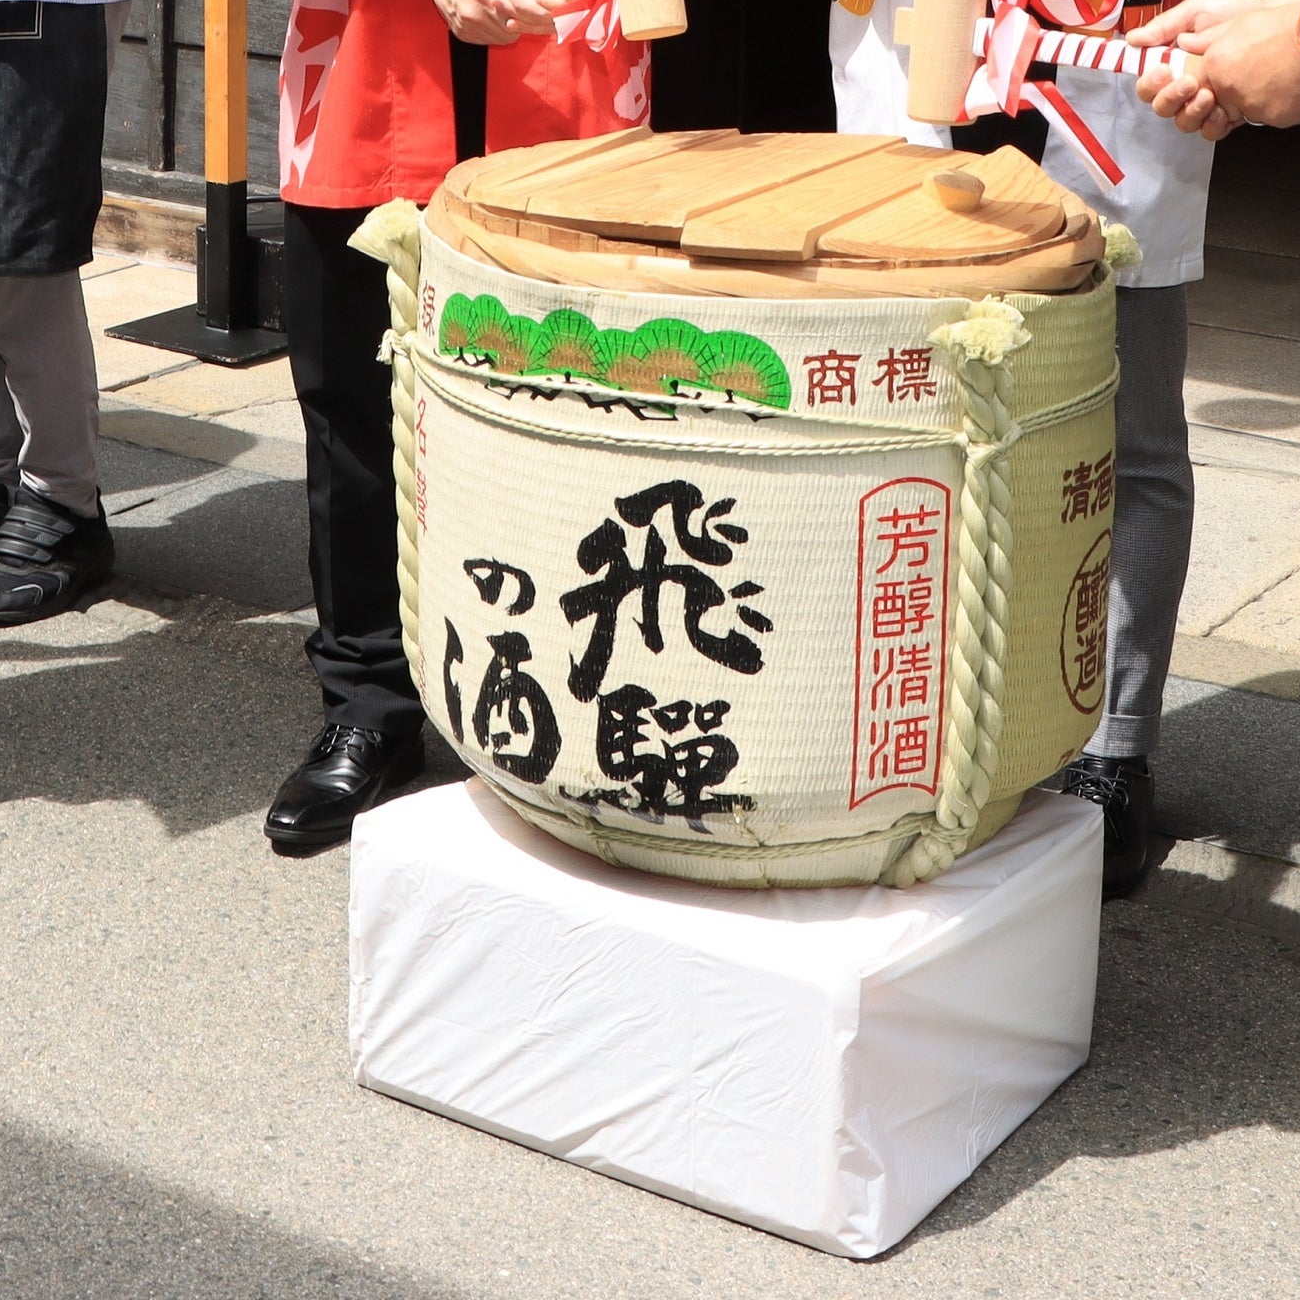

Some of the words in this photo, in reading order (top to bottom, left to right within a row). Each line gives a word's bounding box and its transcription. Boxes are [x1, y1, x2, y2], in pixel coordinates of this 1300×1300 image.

[803, 347, 938, 408] 商標
[867, 503, 942, 781] 芳醇清酒
